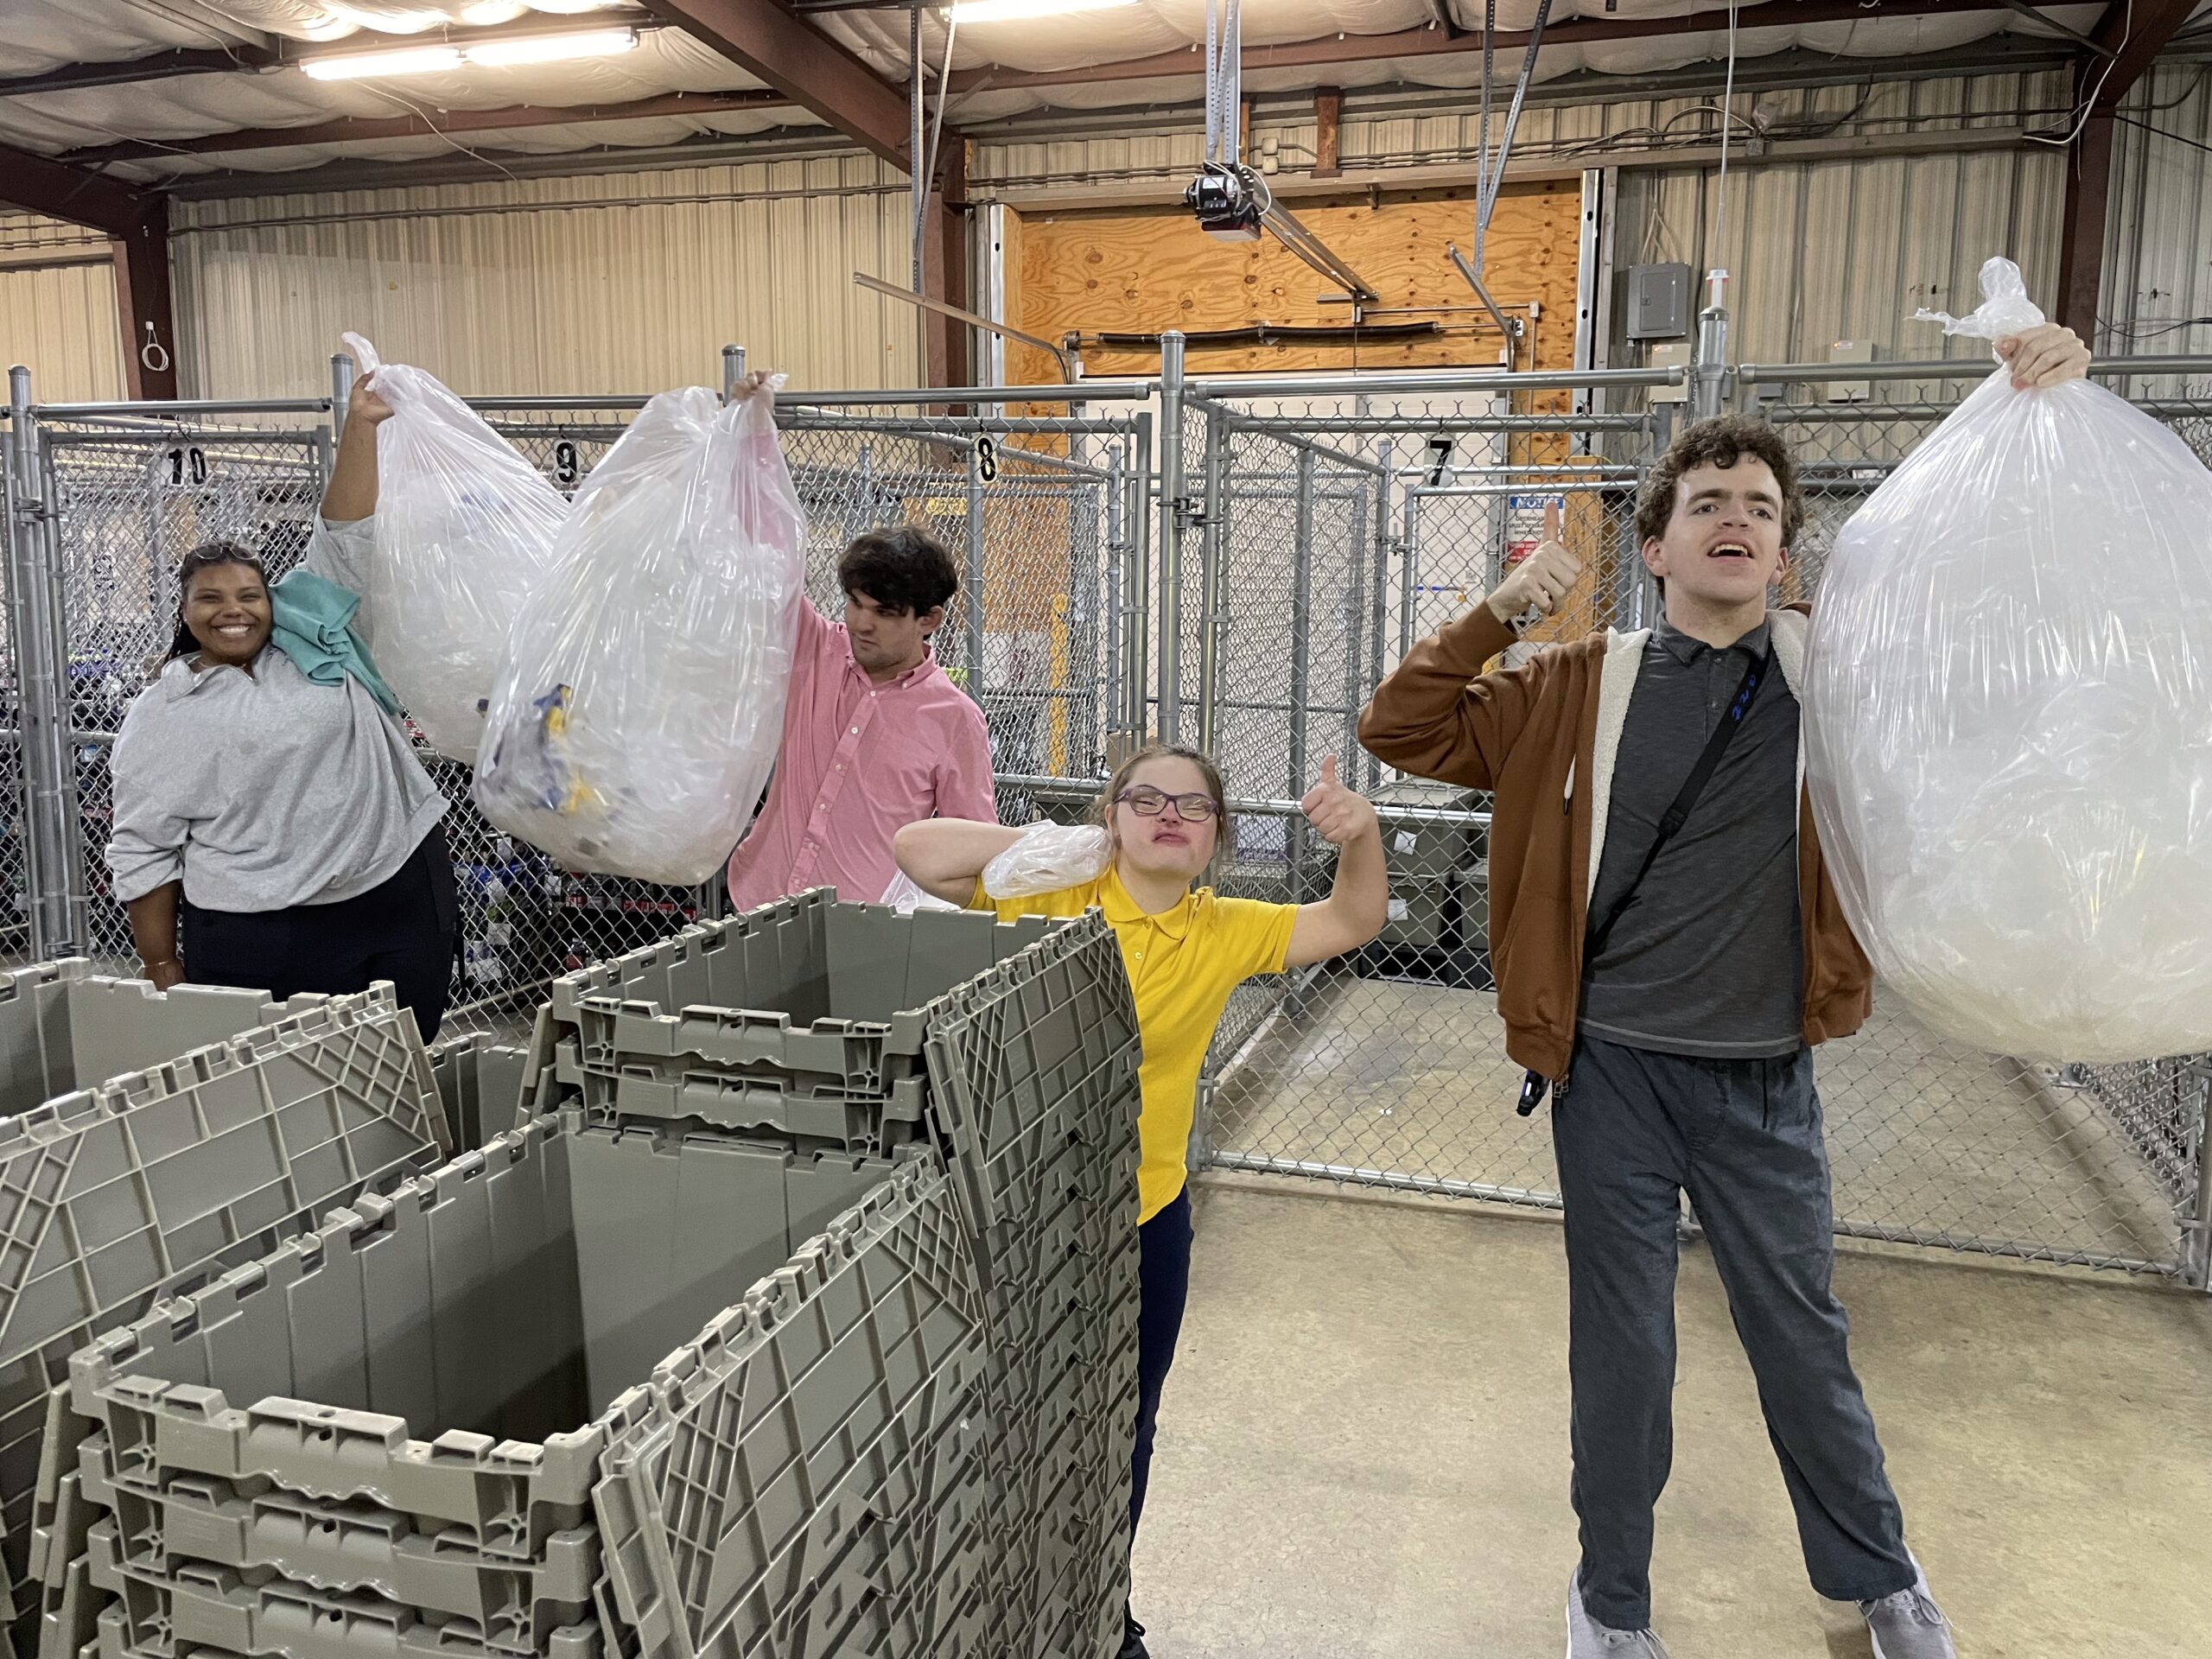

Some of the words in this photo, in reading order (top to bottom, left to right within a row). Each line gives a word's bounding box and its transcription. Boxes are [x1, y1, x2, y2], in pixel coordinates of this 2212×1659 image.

[168, 448, 207, 486] 10
[556, 442, 578, 483] 9
[978, 437, 996, 482] 8
[1429, 440, 1452, 486] 7
